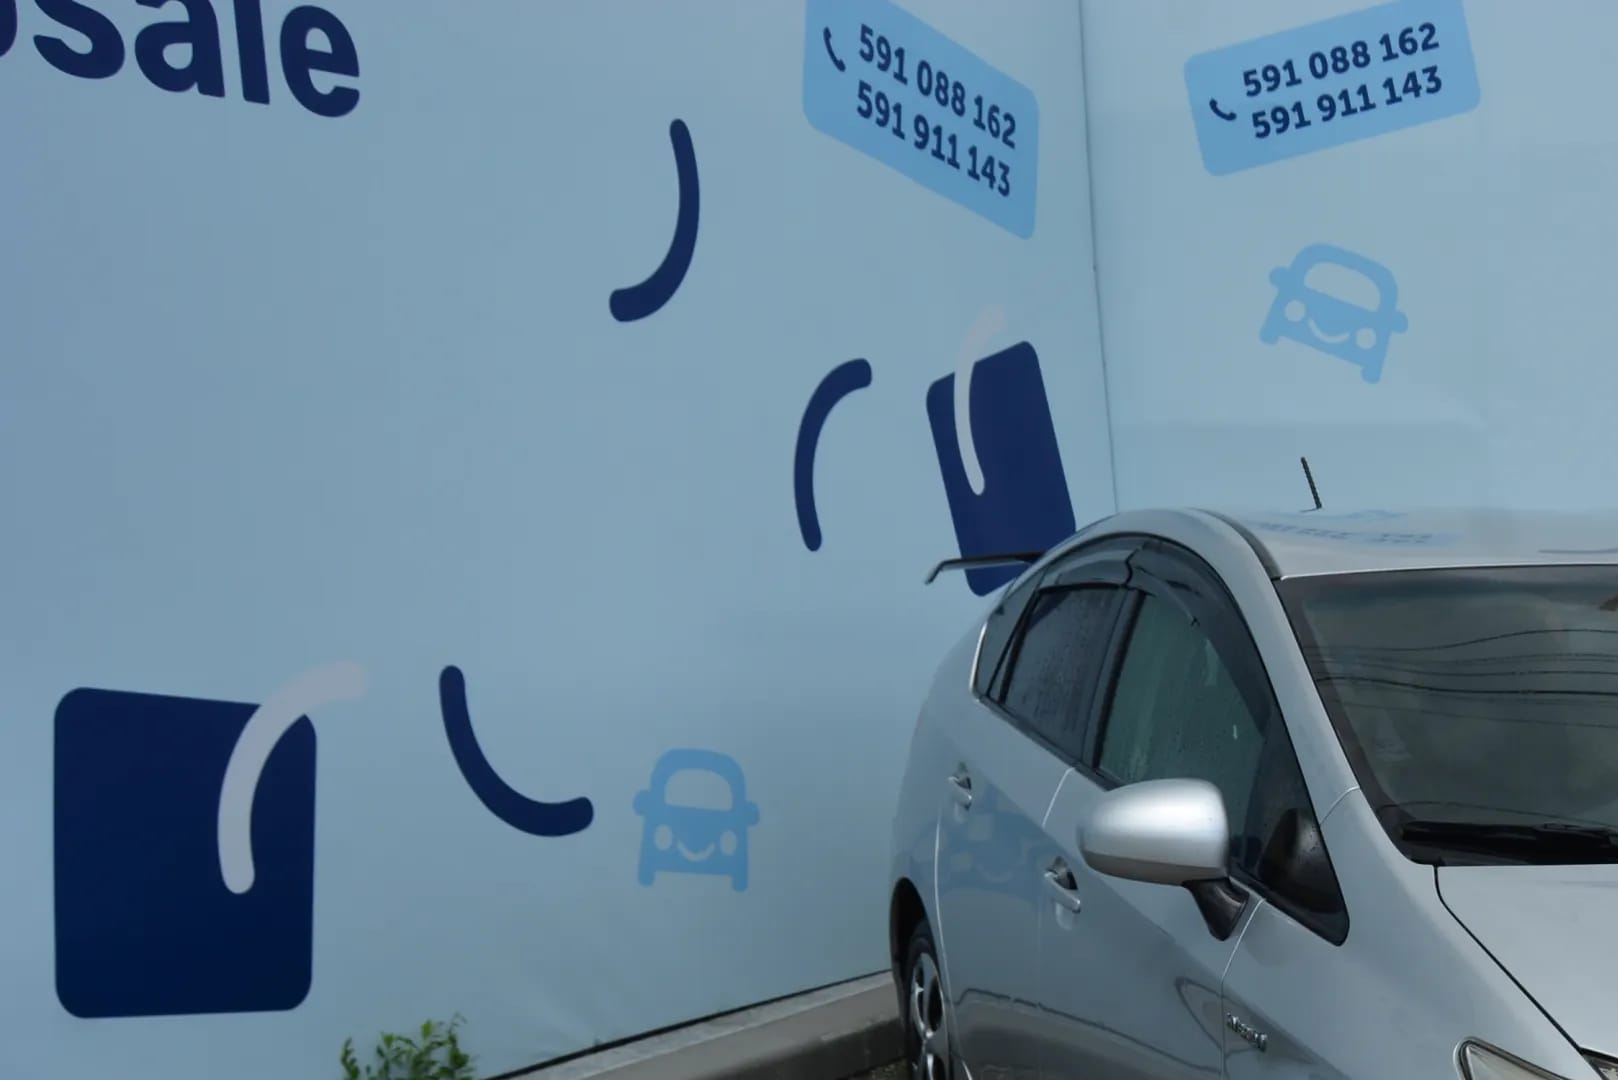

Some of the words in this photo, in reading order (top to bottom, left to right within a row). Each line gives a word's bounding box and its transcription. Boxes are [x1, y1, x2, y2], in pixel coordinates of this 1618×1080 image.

[0, 0, 360, 118] sale
[858, 23, 908, 86] 591
[916, 59, 966, 118] 088
[972, 95, 1017, 150] 162
[1243, 64, 1303, 98] 591
[1308, 46, 1371, 81] 088
[1378, 22, 1441, 62] 162
[1251, 101, 1312, 140] 591
[1316, 84, 1377, 124] 911
[1382, 65, 1443, 105] 143
[856, 79, 906, 141] 591
[913, 114, 961, 171] 911
[967, 144, 1012, 199] 143
